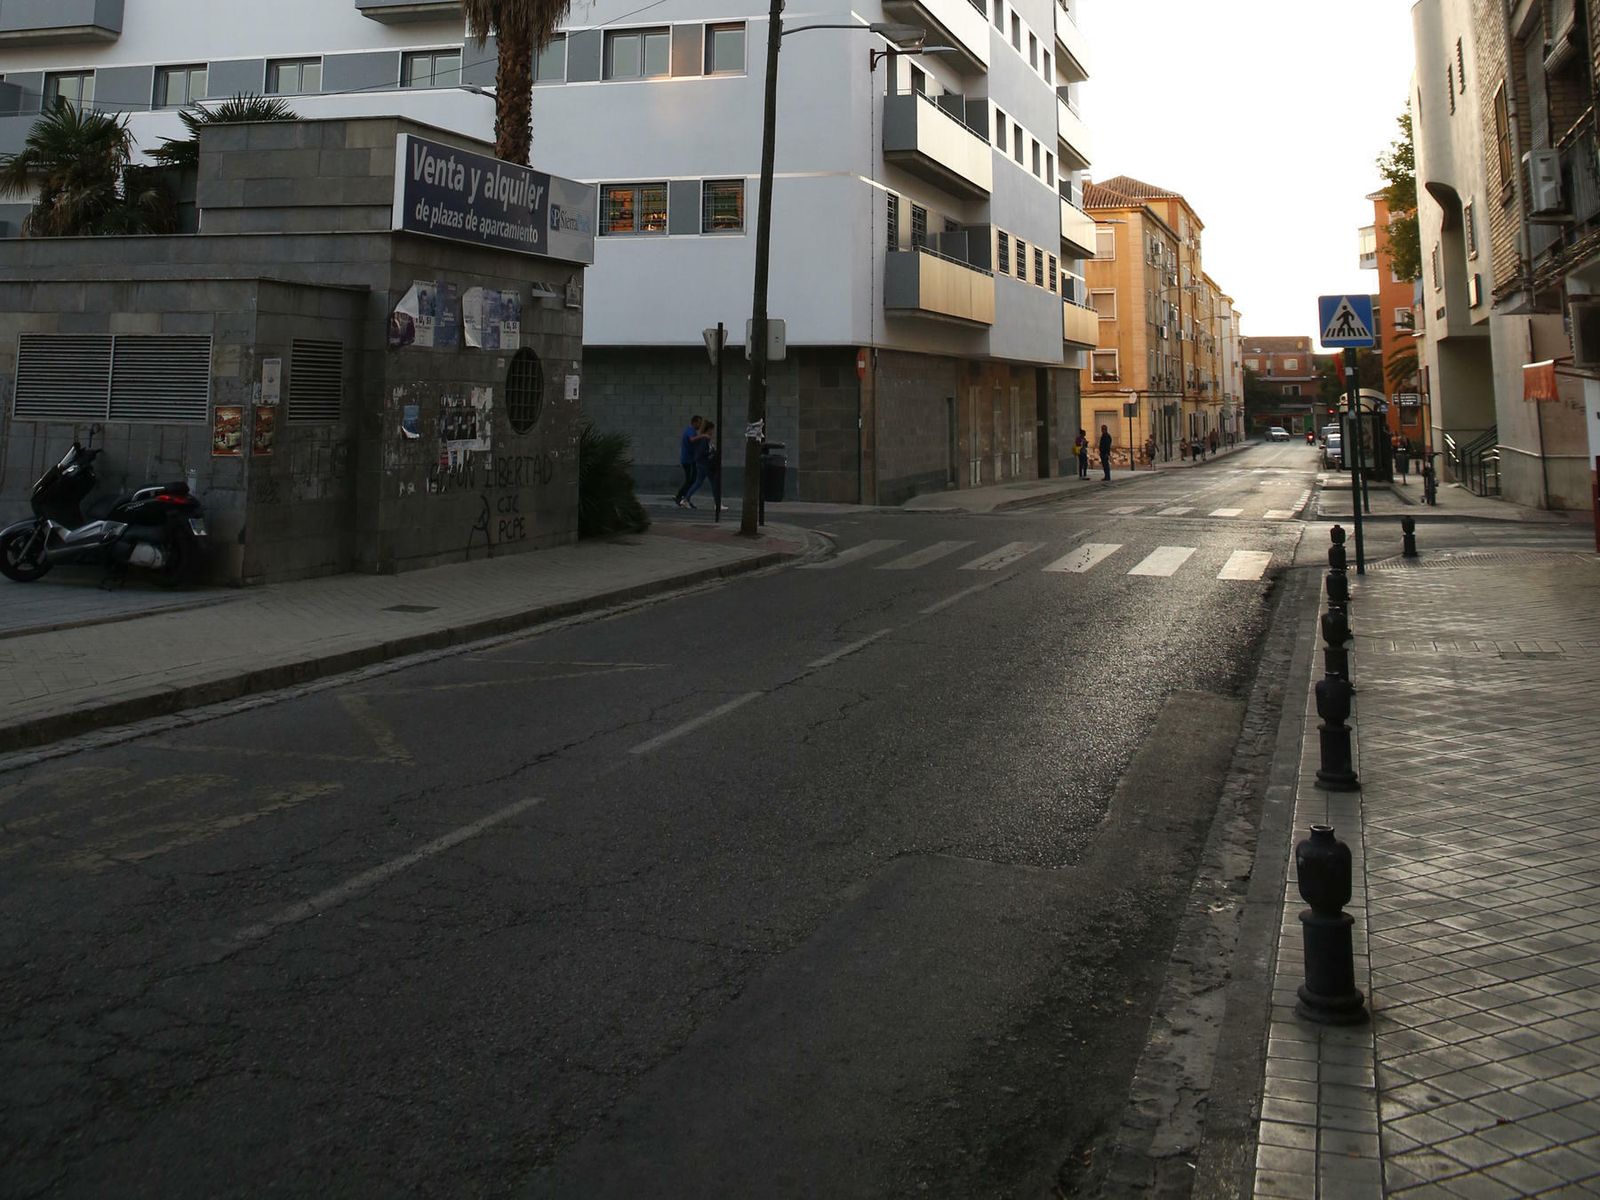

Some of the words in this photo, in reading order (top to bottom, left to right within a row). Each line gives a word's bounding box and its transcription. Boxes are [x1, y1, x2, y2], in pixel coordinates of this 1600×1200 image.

[412, 143, 464, 192] Venta
[468, 167, 482, 204] y
[484, 164, 544, 212] alquiler
[415, 198, 430, 222] de
[430, 202, 463, 229] plazas
[465, 209, 478, 231] de
[479, 215, 539, 244] aparcamiento
[484, 454, 553, 488] LIBERTAD
[497, 494, 520, 514] CJC
[498, 516, 526, 541] PCPE
